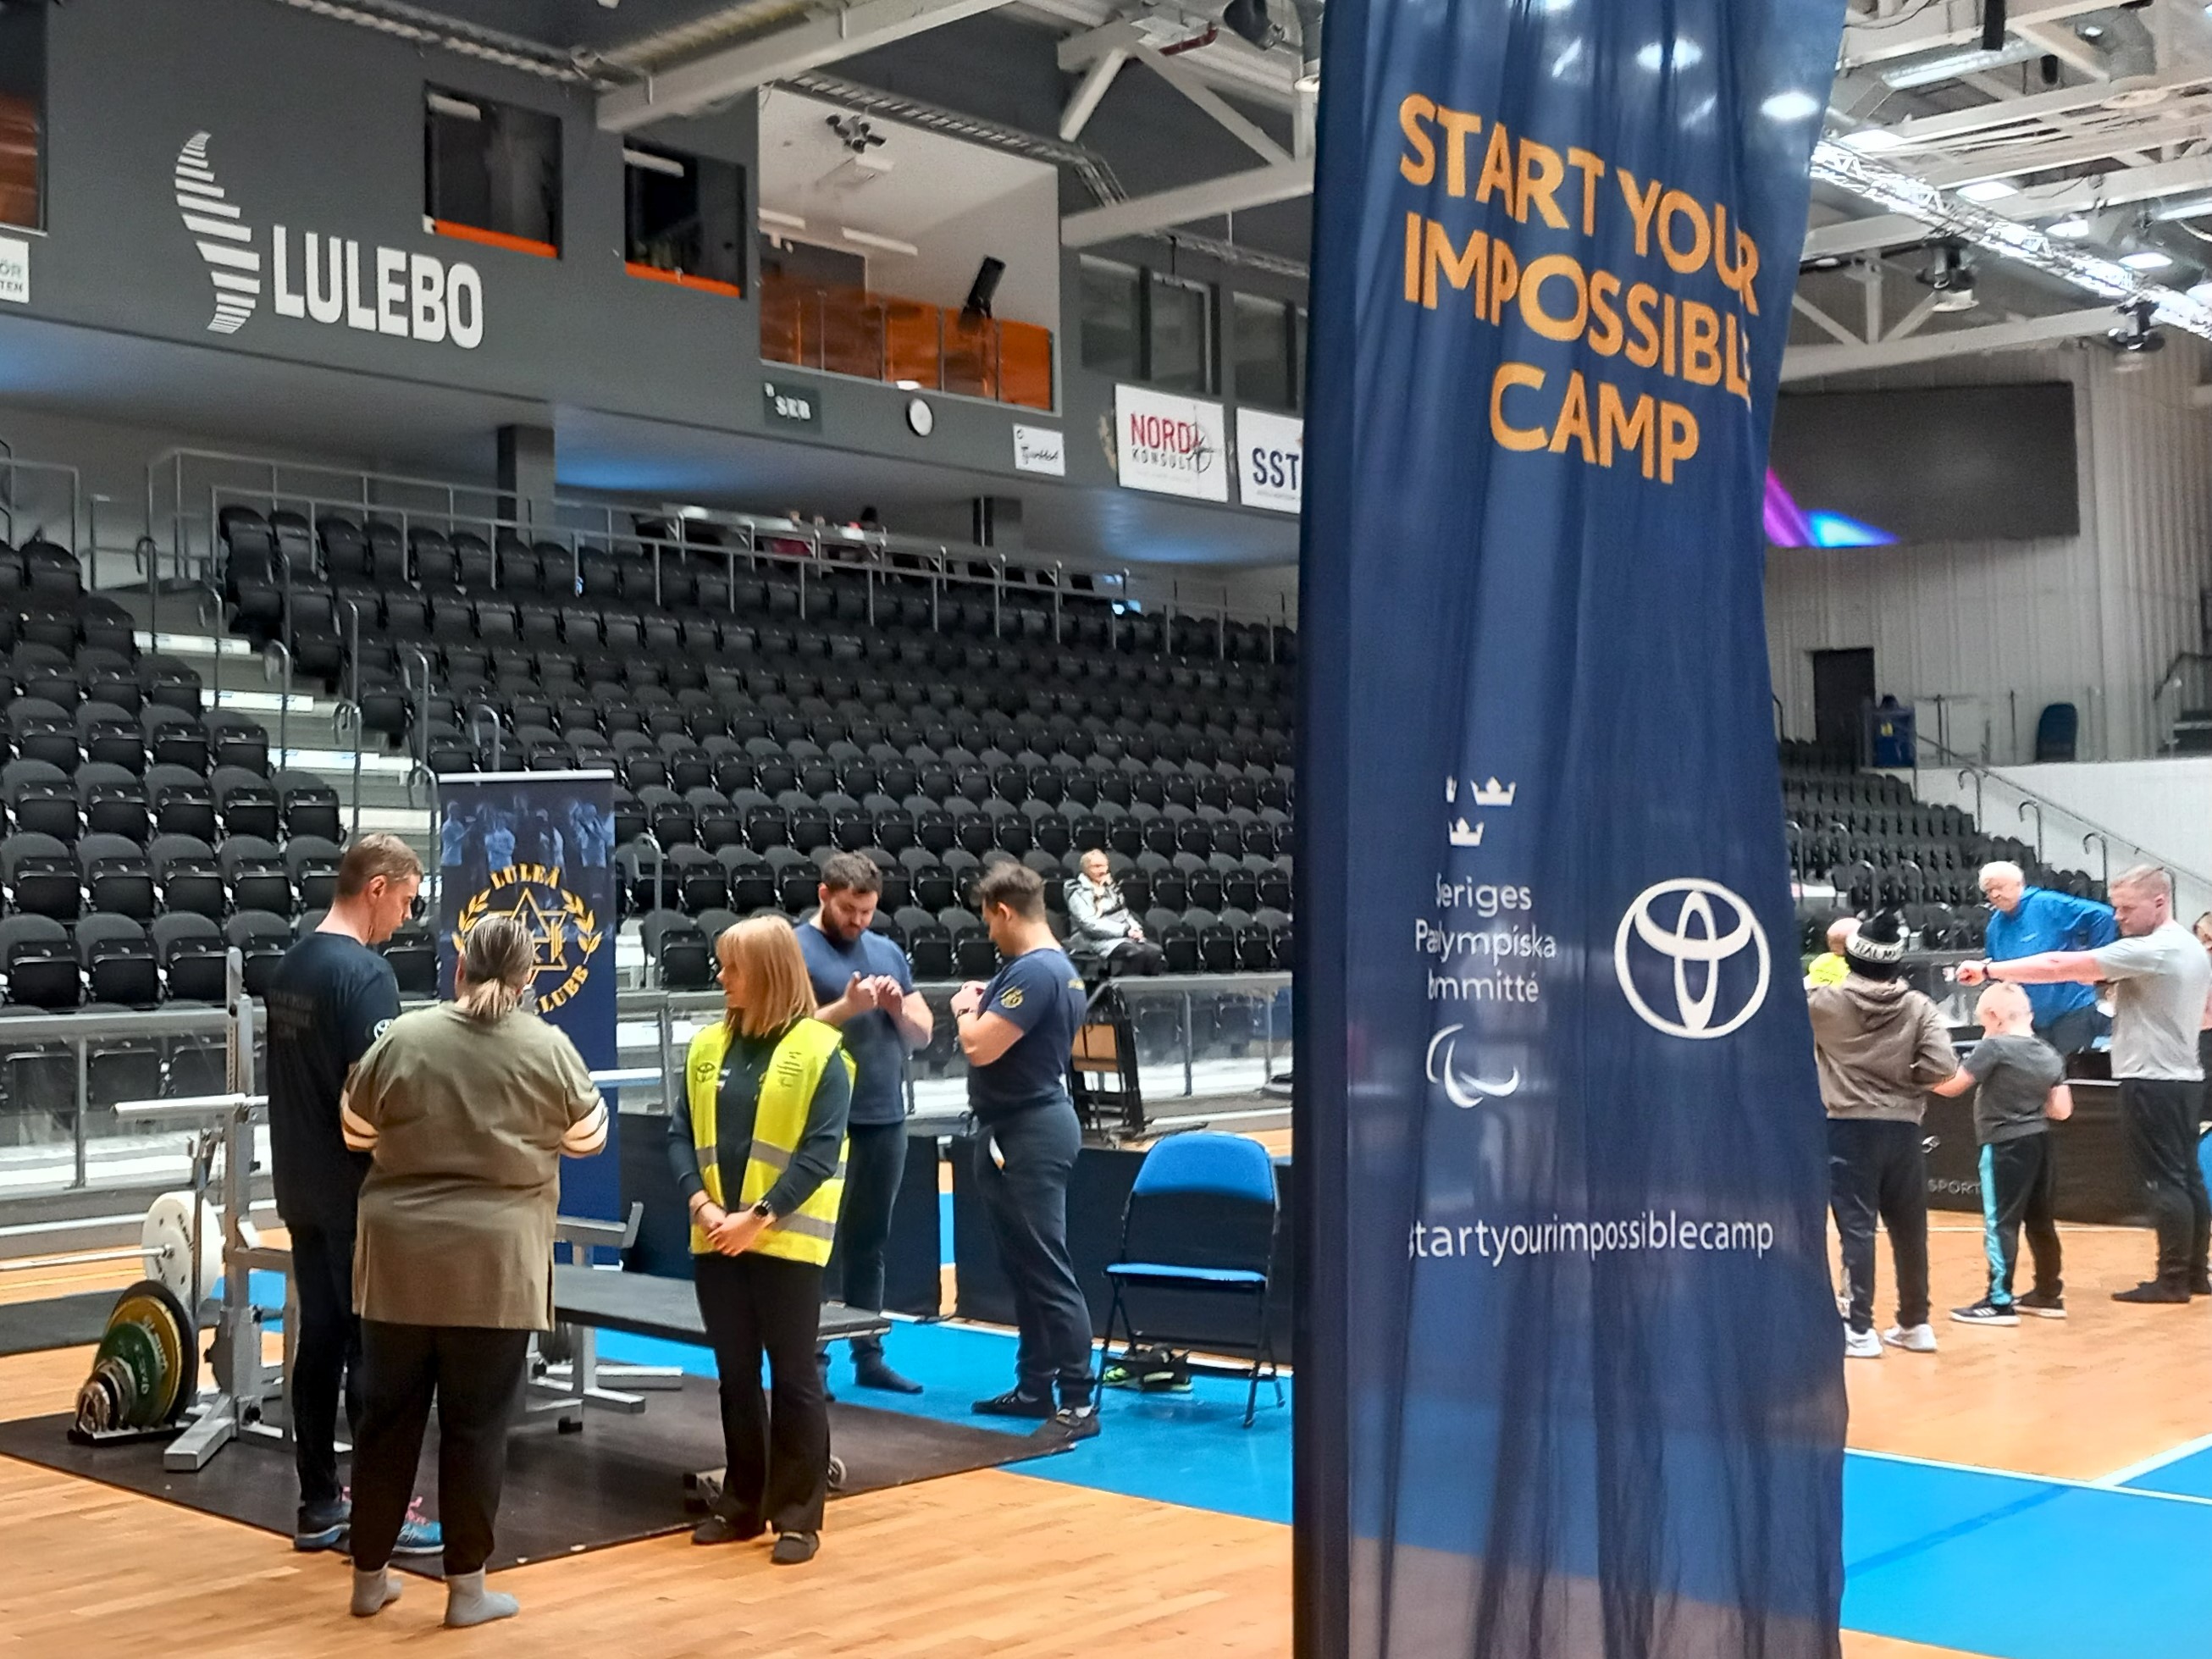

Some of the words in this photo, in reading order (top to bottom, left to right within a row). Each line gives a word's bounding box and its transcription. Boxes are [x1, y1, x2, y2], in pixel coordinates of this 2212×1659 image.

[1399, 92, 1606, 238] START
[1616, 167, 1760, 316] YOUR
[273, 224, 484, 350] LULEBO
[1404, 210, 1751, 412] IMPOSSIBL
[1131, 412, 1191, 455] NORD
[1131, 447, 1192, 473] KONSULT
[1490, 361, 1700, 484] CAMP
[1253, 447, 1300, 490] SST
[535, 965, 589, 1015] LUBB
